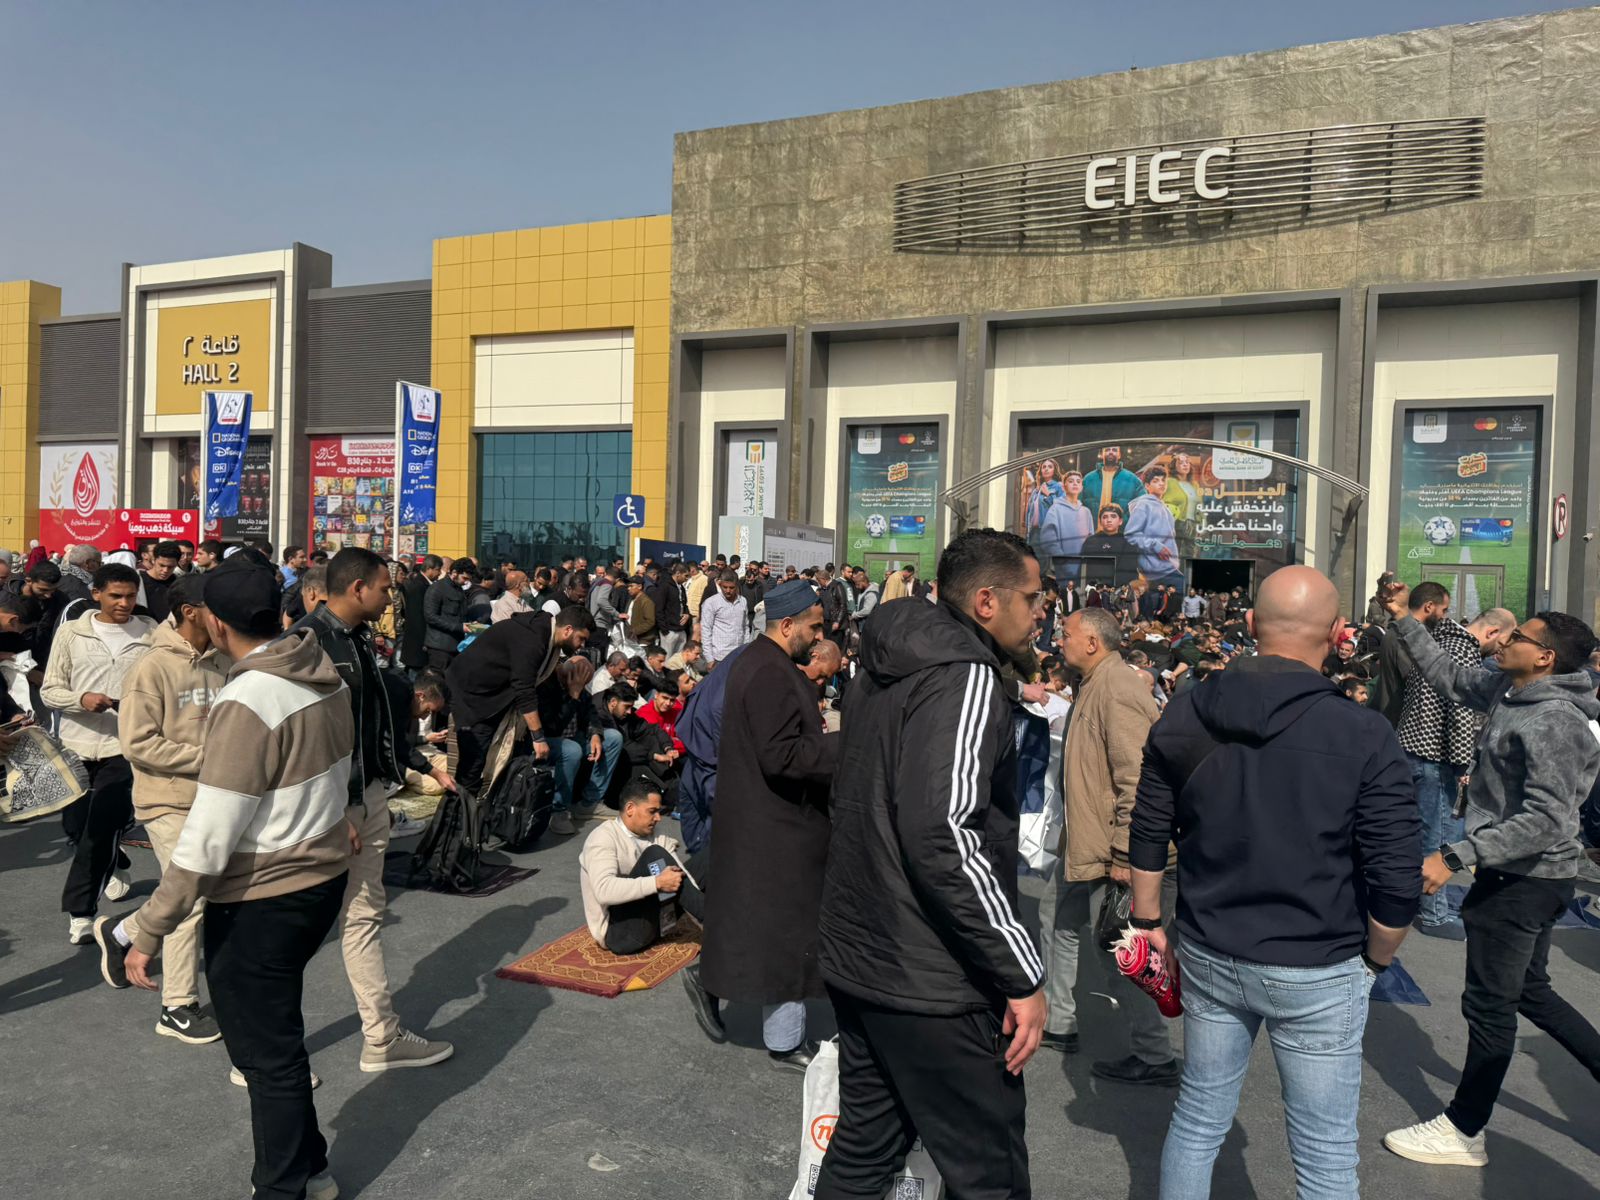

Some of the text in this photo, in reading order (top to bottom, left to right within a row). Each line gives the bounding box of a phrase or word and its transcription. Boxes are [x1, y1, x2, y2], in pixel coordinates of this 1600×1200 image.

[1084, 147, 1230, 209] EIEC
[201, 335, 239, 354] قاعة
[183, 362, 239, 384] HALL 2
[1196, 500, 1223, 515] عليه
[1195, 518, 1247, 533] هنكمل
